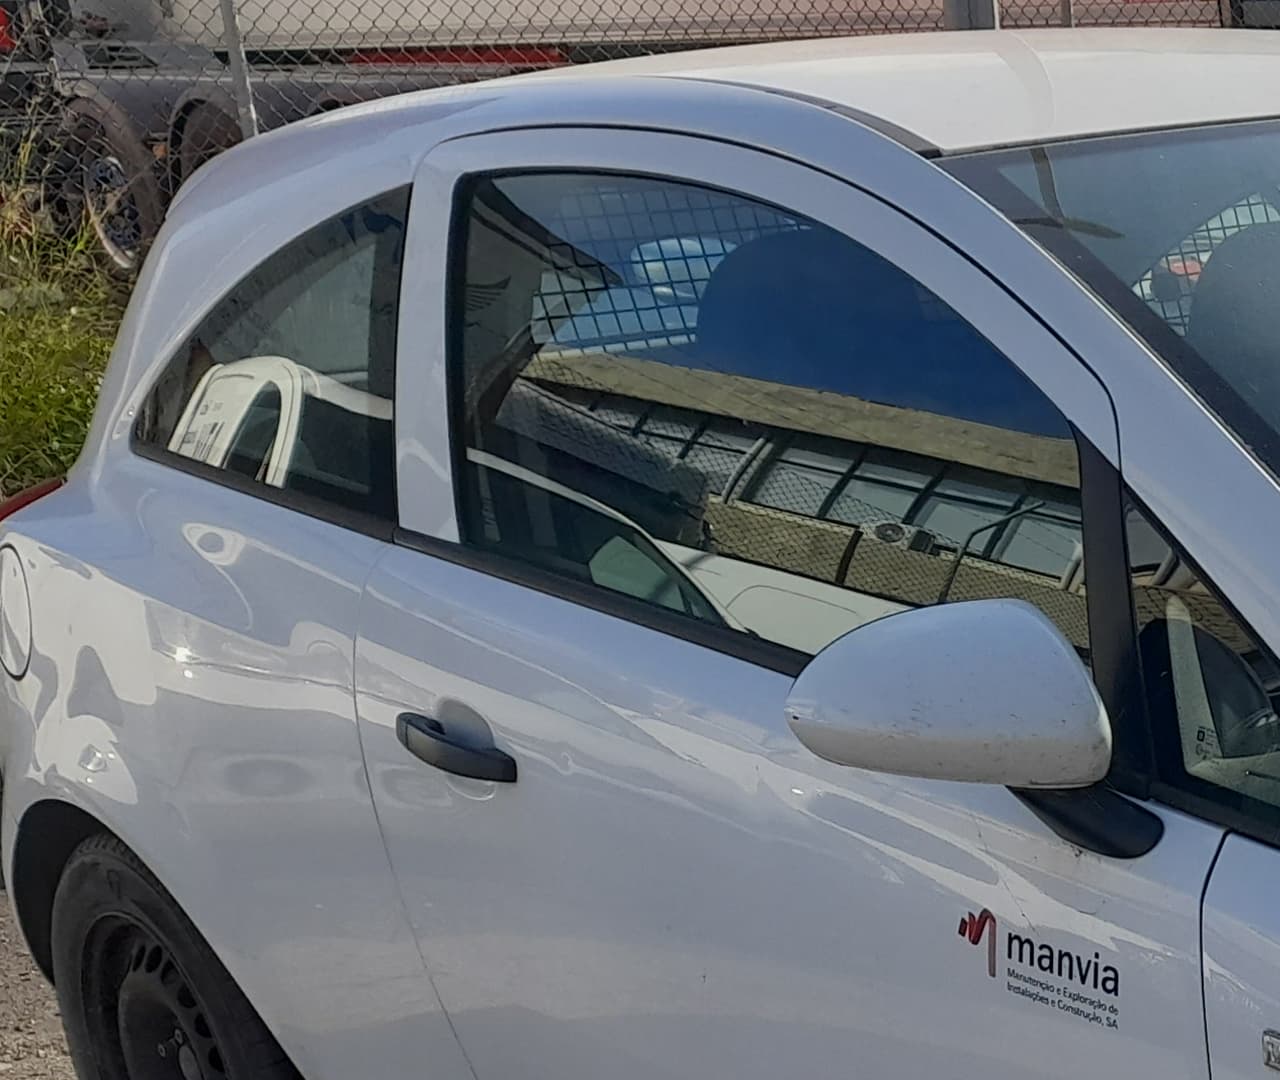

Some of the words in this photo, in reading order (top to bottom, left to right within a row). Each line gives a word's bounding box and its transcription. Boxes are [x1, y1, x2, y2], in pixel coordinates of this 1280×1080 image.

[1007, 932, 1120, 997] manvia
[1007, 967, 1055, 993] Manutenção
[1063, 987, 1108, 1011] Exploração
